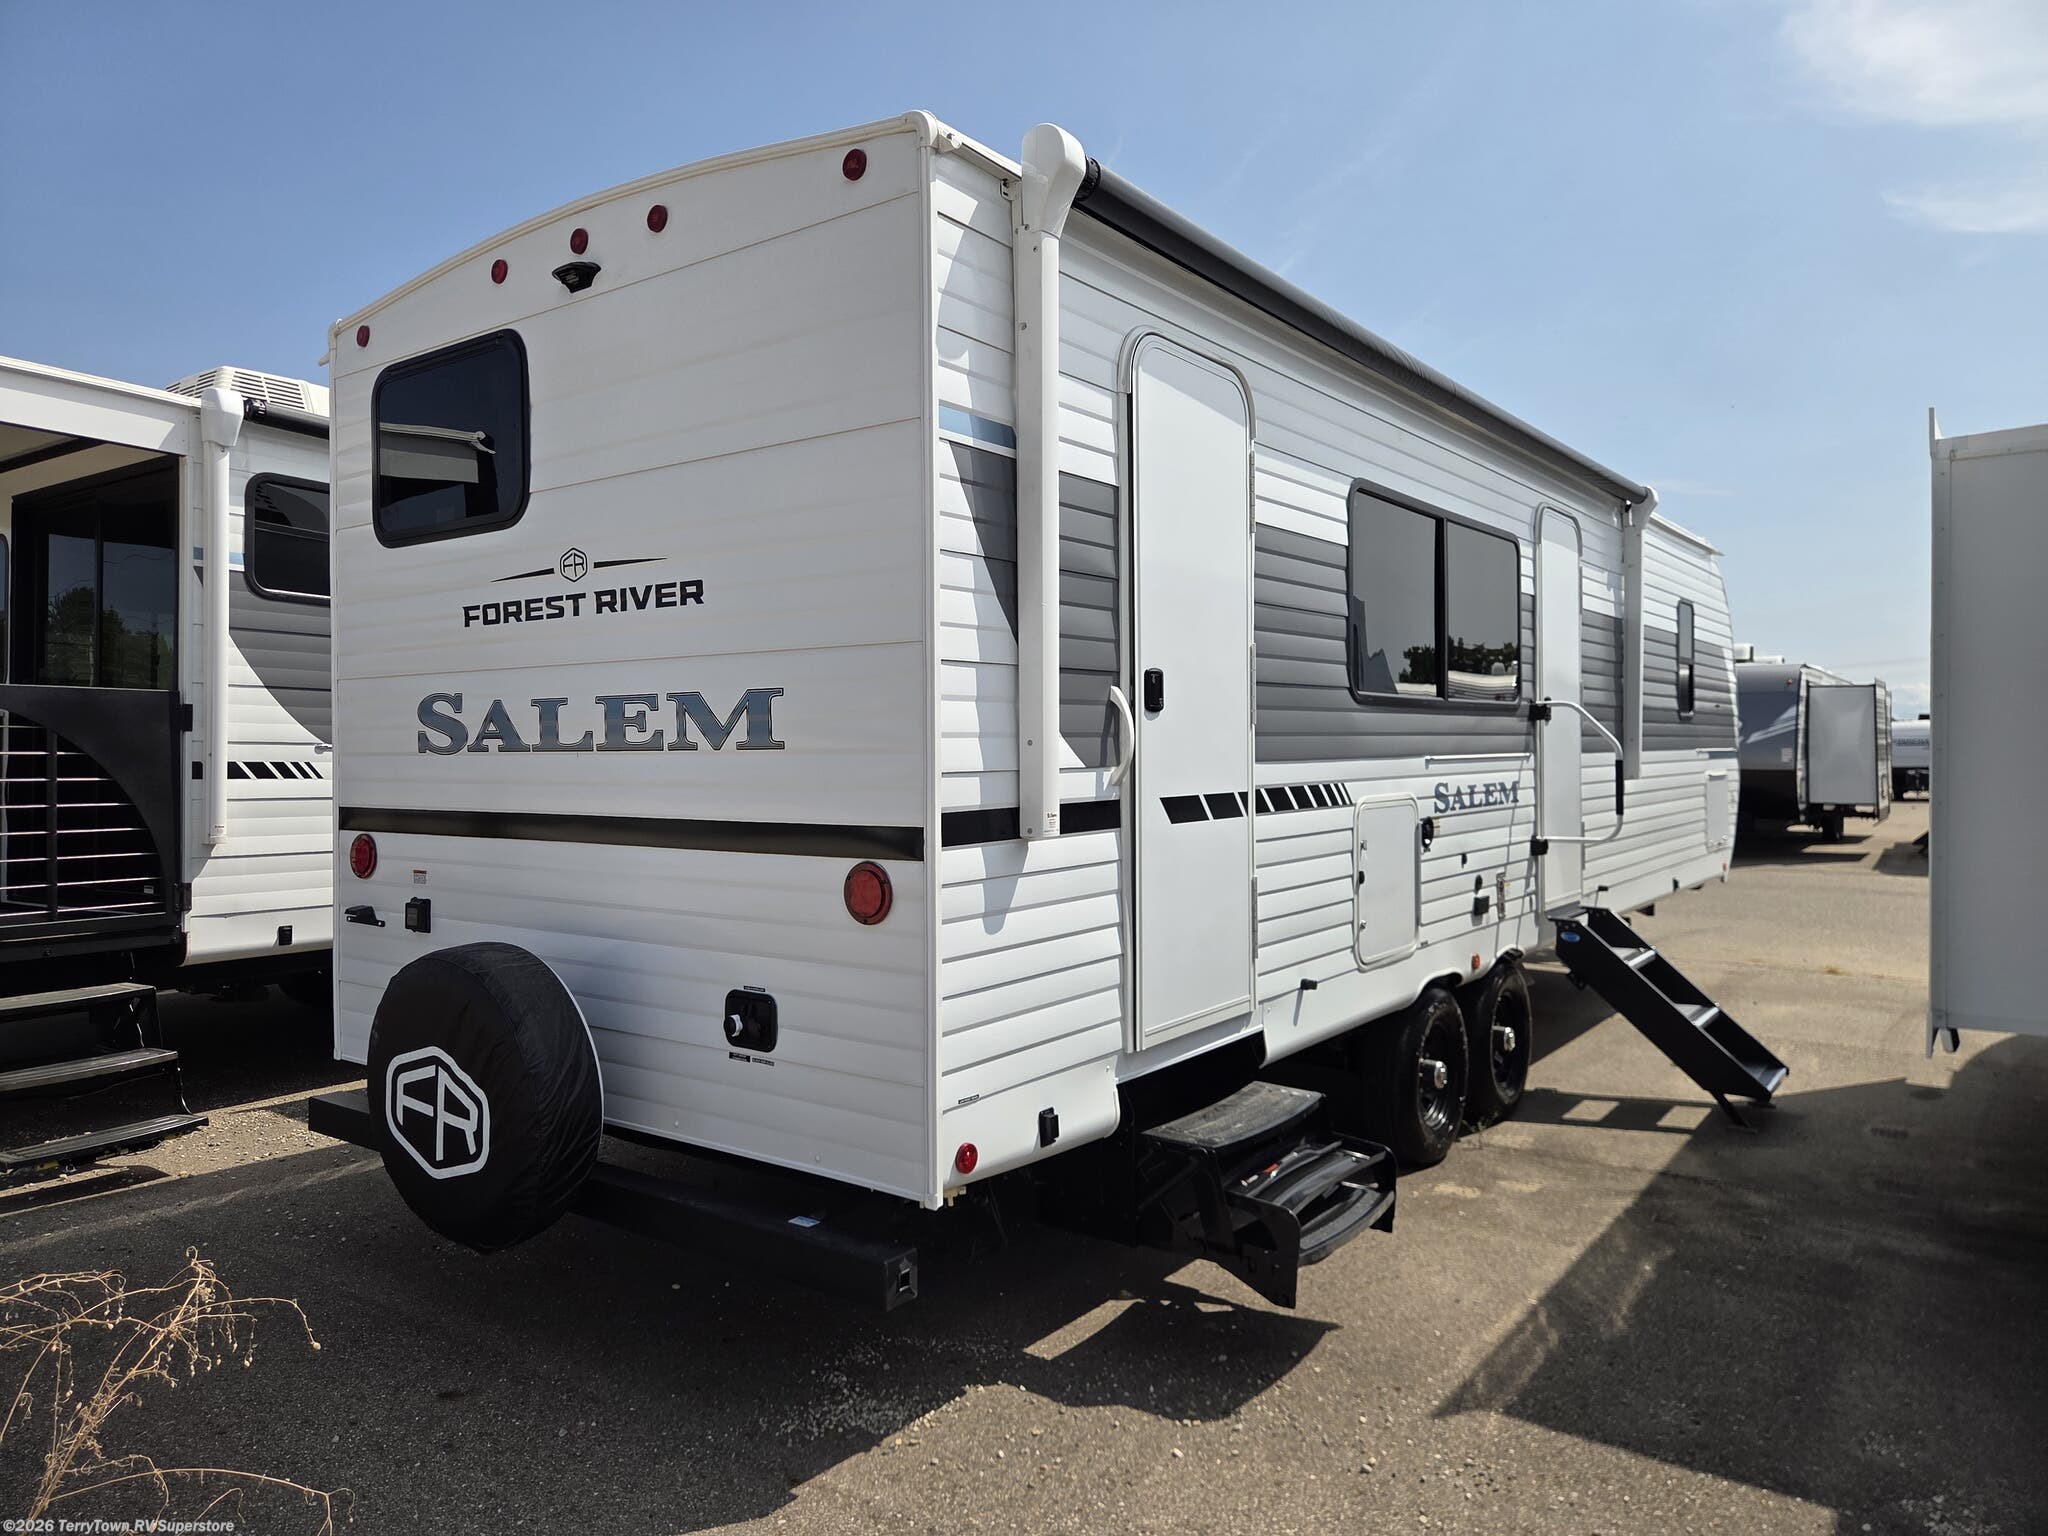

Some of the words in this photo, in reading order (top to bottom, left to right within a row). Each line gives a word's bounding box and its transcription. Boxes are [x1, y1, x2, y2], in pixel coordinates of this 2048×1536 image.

[463, 592, 586, 628] FOREST
[594, 579, 704, 614] RIVER
[417, 688, 785, 756] SALEM
[1434, 781, 1519, 813] SALEM
[396, 1064, 479, 1162] FR
